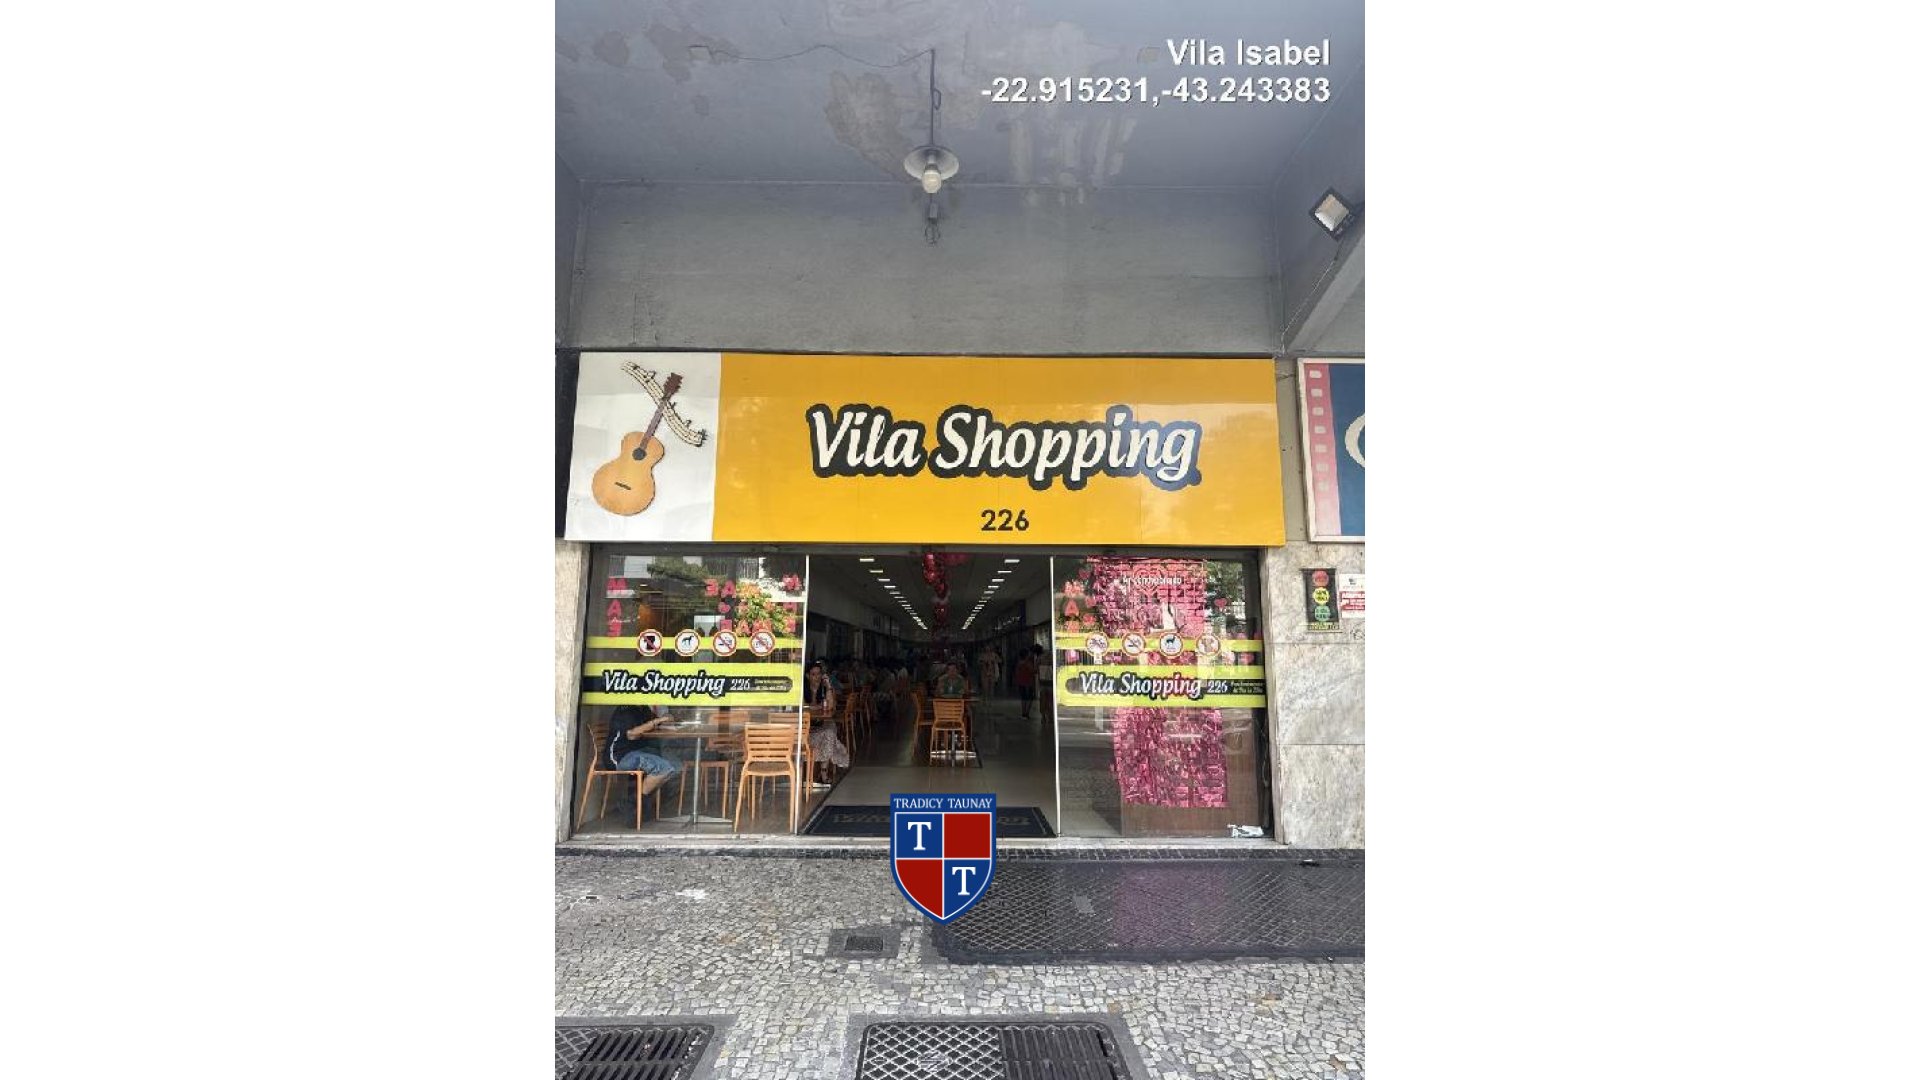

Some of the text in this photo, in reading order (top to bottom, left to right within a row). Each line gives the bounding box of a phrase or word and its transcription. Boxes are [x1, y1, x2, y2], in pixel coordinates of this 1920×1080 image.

[811, 406, 1199, 484] Vila Shopping
[980, 509, 1030, 531] 226
[603, 670, 751, 697] Vila Shopping 226
[1079, 672, 1229, 699] Vila Shopping 226
